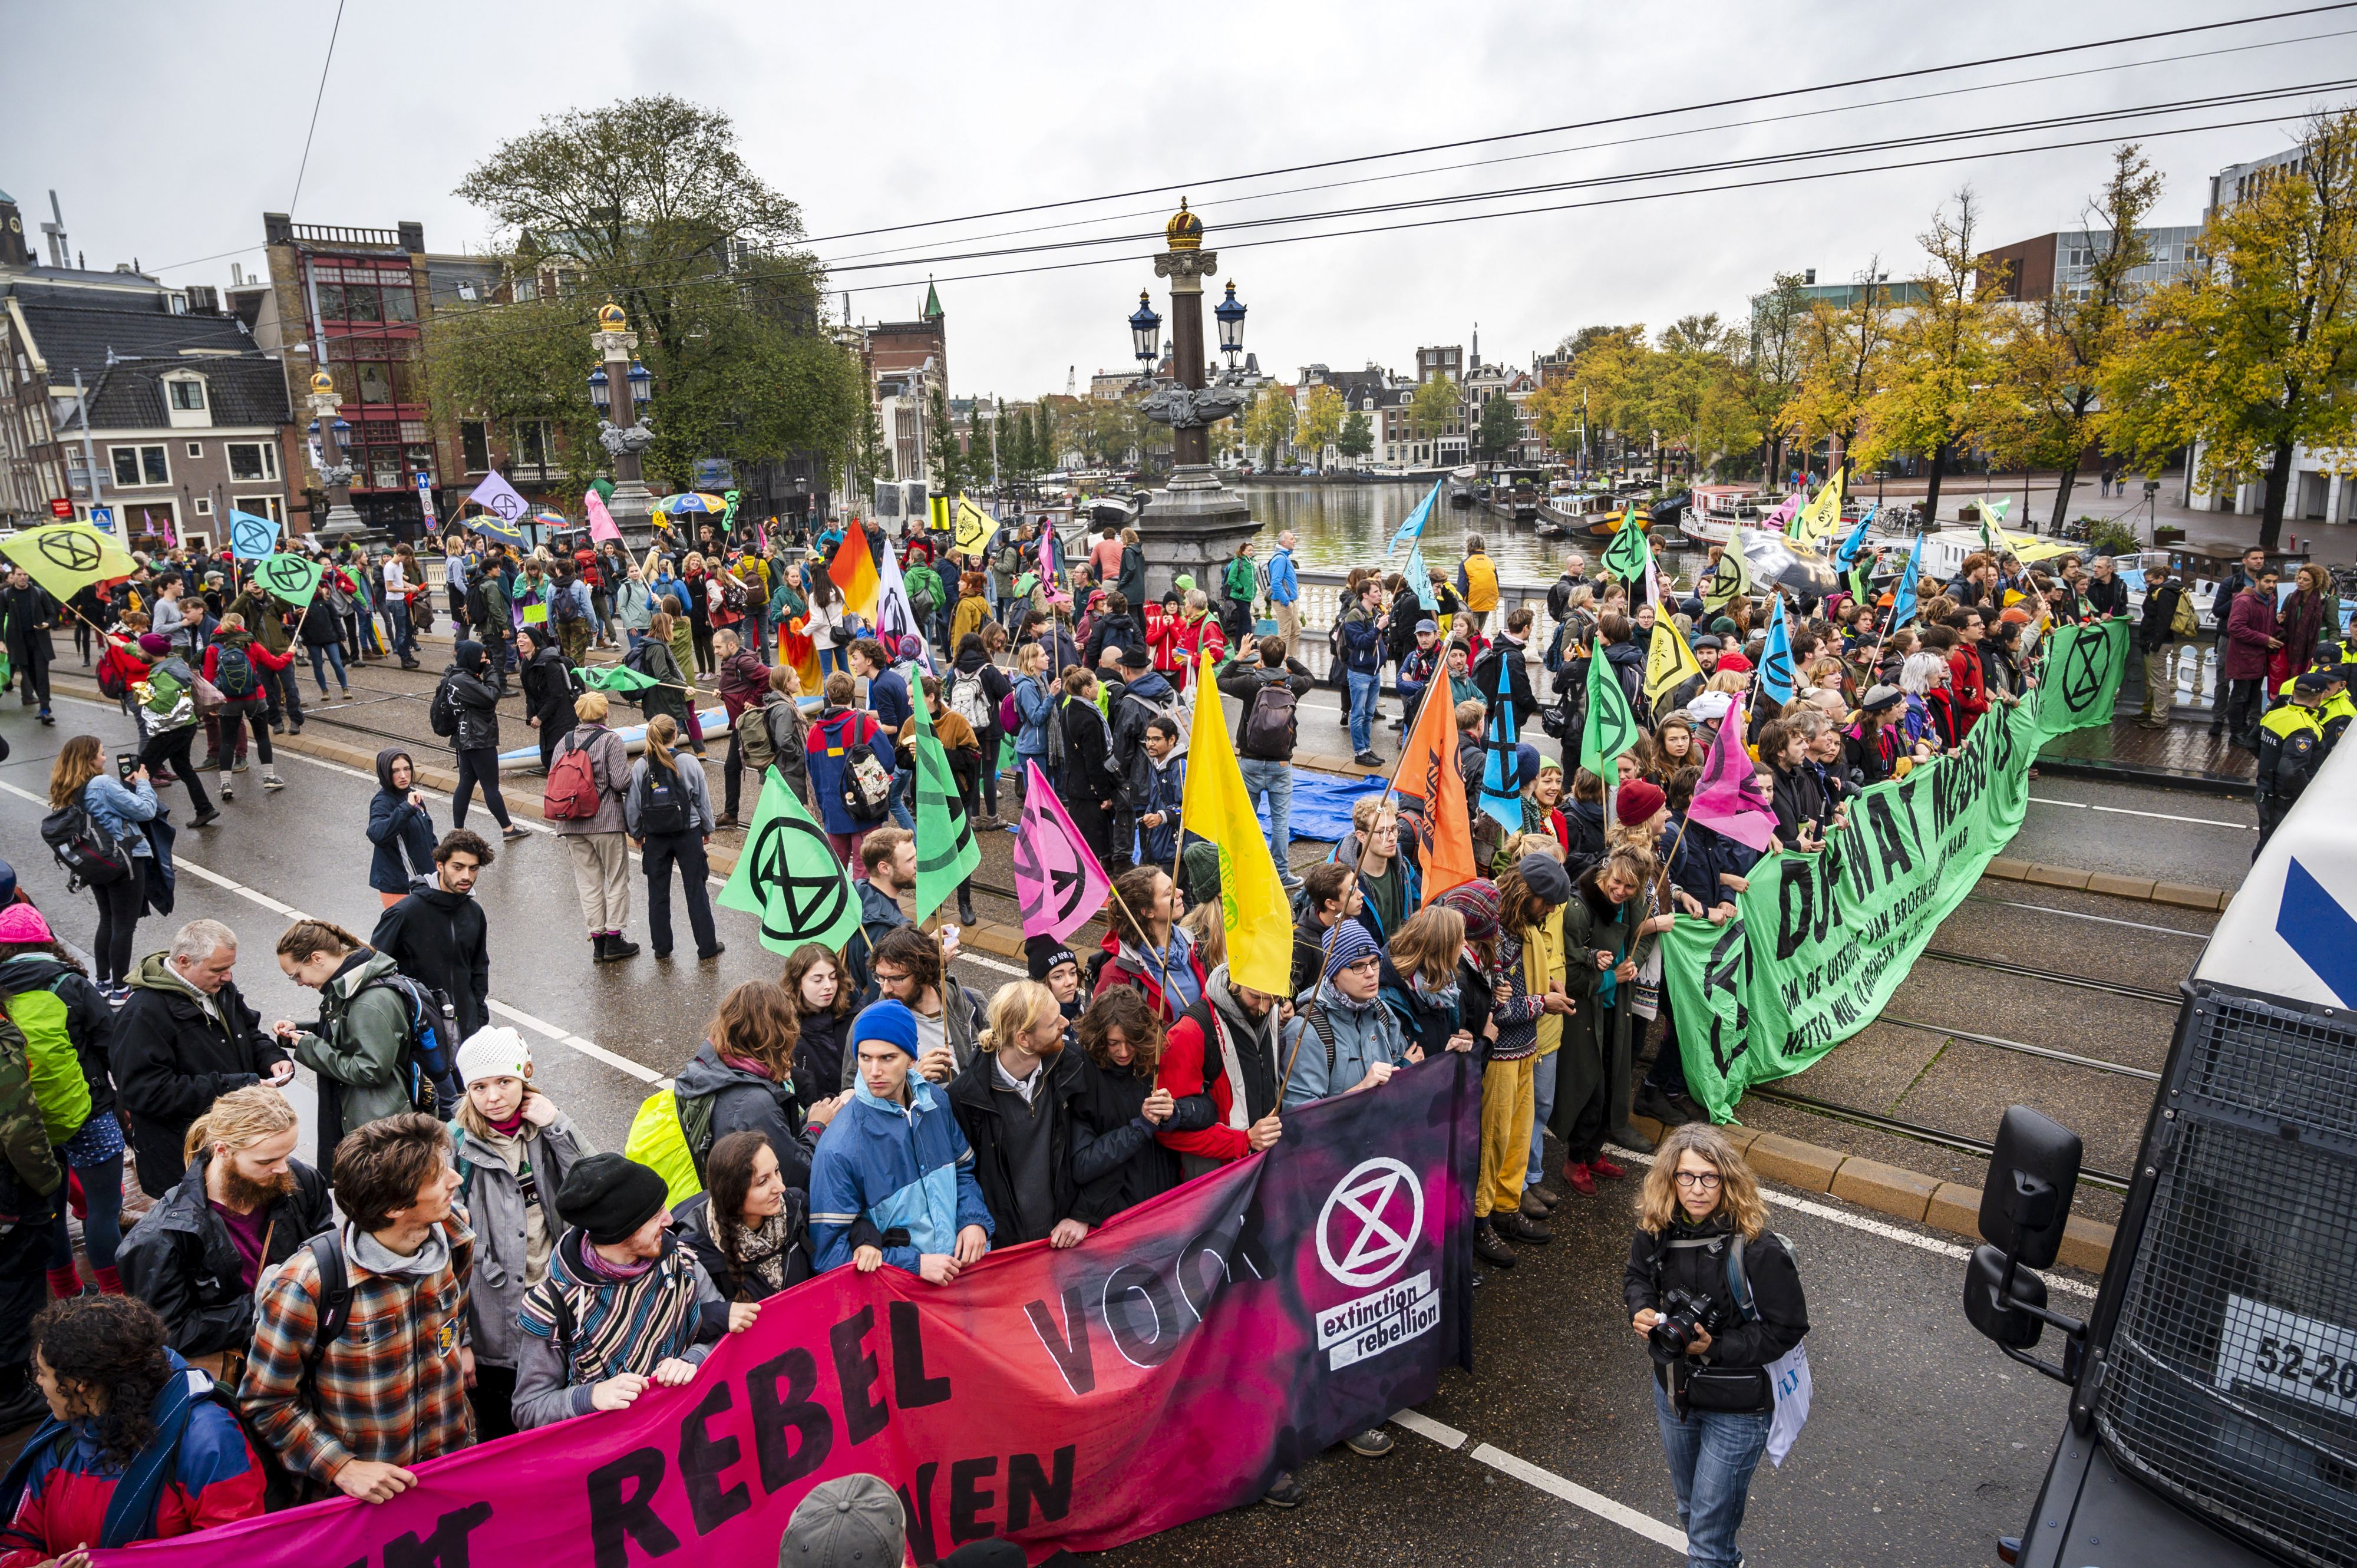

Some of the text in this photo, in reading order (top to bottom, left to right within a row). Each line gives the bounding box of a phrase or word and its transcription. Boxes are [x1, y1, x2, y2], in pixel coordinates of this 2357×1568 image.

[1843, 778, 1925, 904] WAT
[1781, 977, 1801, 1015] OM
[1807, 965, 1823, 999] DE
[1866, 910, 1889, 945] VAN
[1947, 826, 1969, 861] NAAR
[1781, 1011, 1832, 1058] NETTO
[1830, 992, 1861, 1029] NUL
[1323, 1286, 1418, 1338] extinction
[1356, 1303, 1437, 1357] rebellion
[586, 1300, 951, 1568] REBEL
[899, 1444, 1076, 1567] VEN
